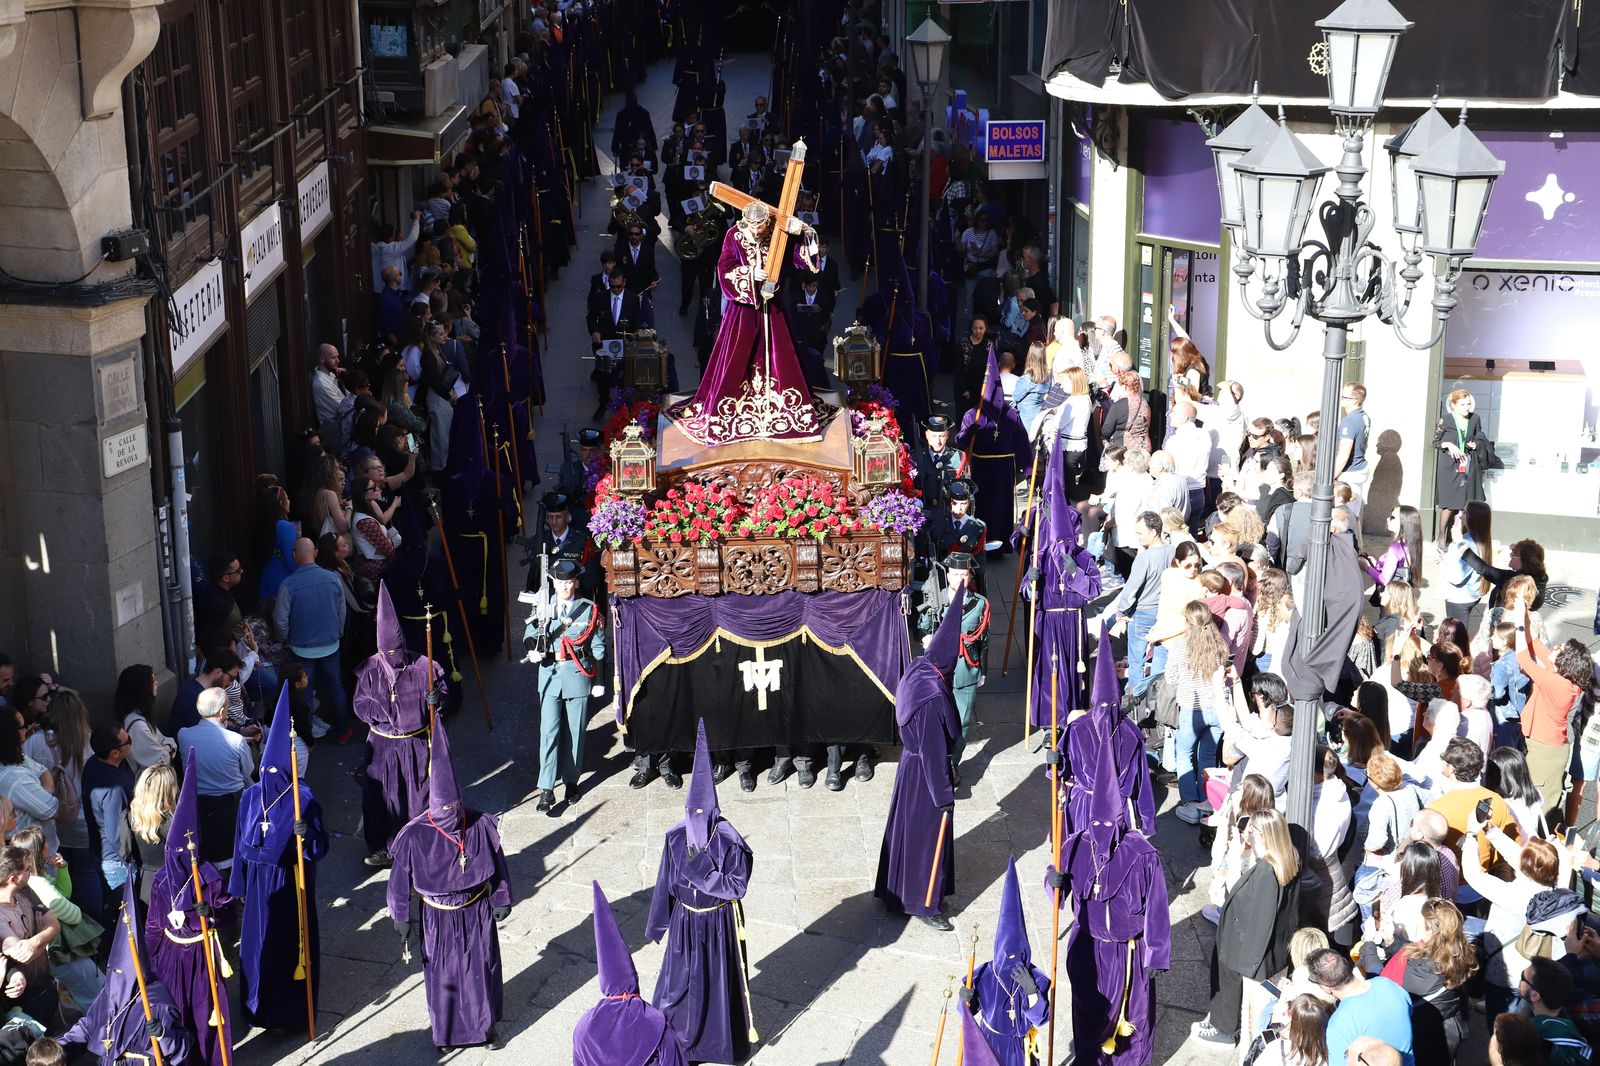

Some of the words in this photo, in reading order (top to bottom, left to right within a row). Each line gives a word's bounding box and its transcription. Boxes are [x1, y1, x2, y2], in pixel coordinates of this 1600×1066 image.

[992, 126, 1039, 140] BOLSOS
[989, 144, 1041, 158] MALETAS
[252, 233, 267, 268] PLAZA
[1173, 272, 1216, 283] #vnta
[108, 366, 130, 387] CALLE
[118, 433, 137, 447] CALLE
[117, 447, 125, 458] DE
[127, 444, 136, 454] LA
[116, 453, 138, 469] RENOVA
